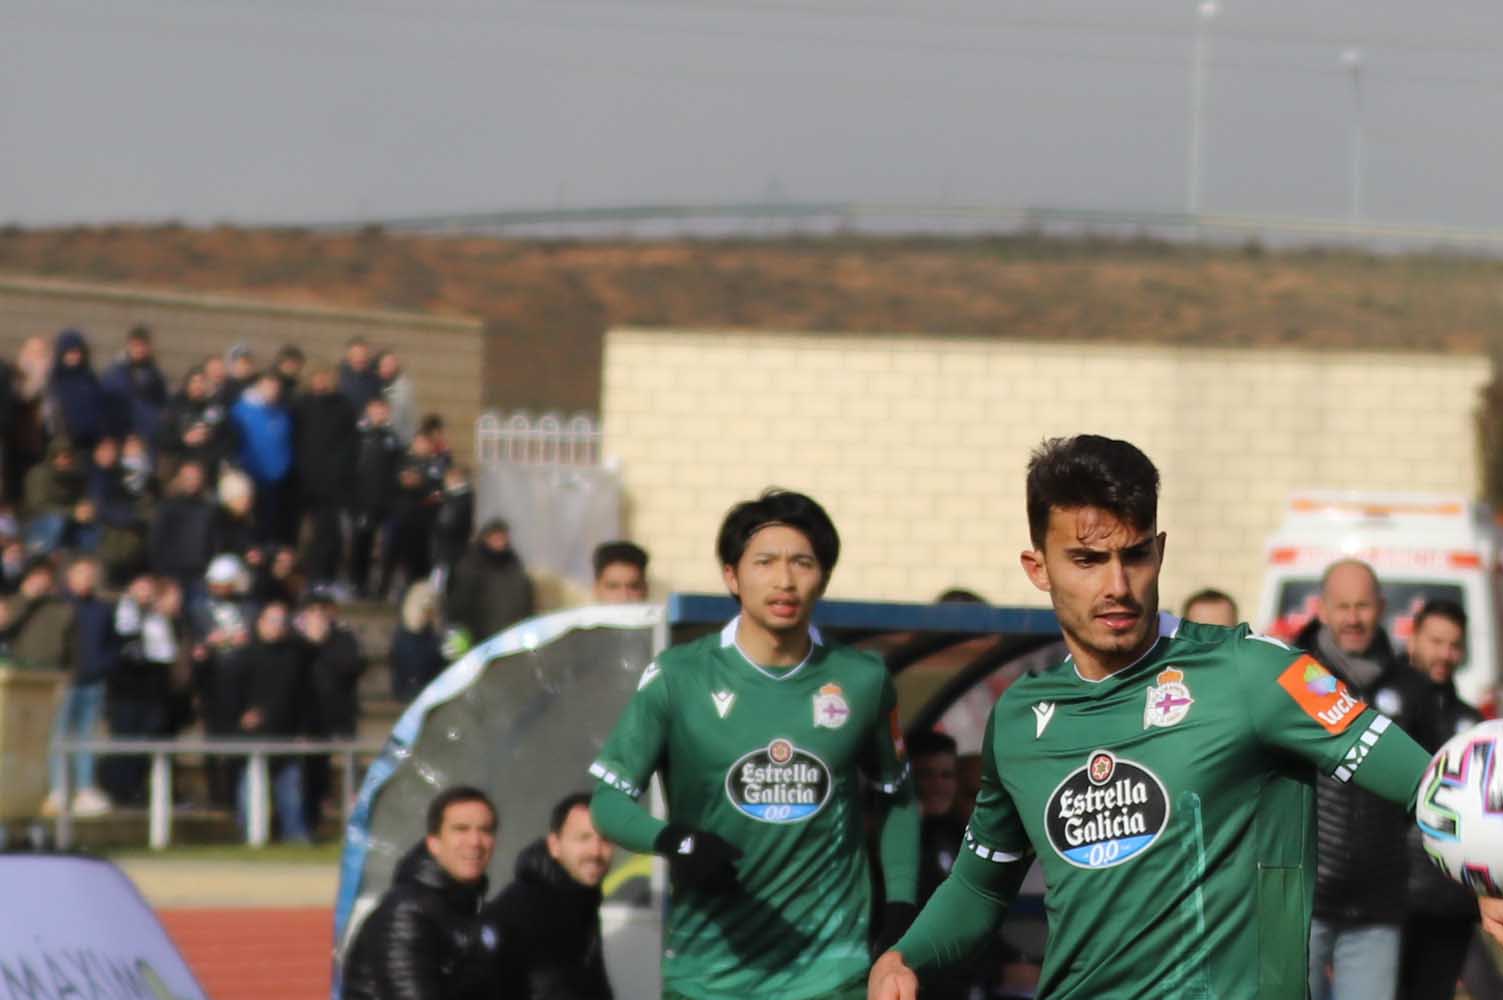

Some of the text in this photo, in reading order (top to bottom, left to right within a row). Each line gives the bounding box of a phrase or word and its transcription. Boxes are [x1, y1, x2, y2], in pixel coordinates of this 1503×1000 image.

[741, 762, 818, 783] Estrella
[743, 784, 816, 805] Galicia
[1058, 778, 1149, 819] Estrella
[1064, 807, 1147, 846] Galicia
